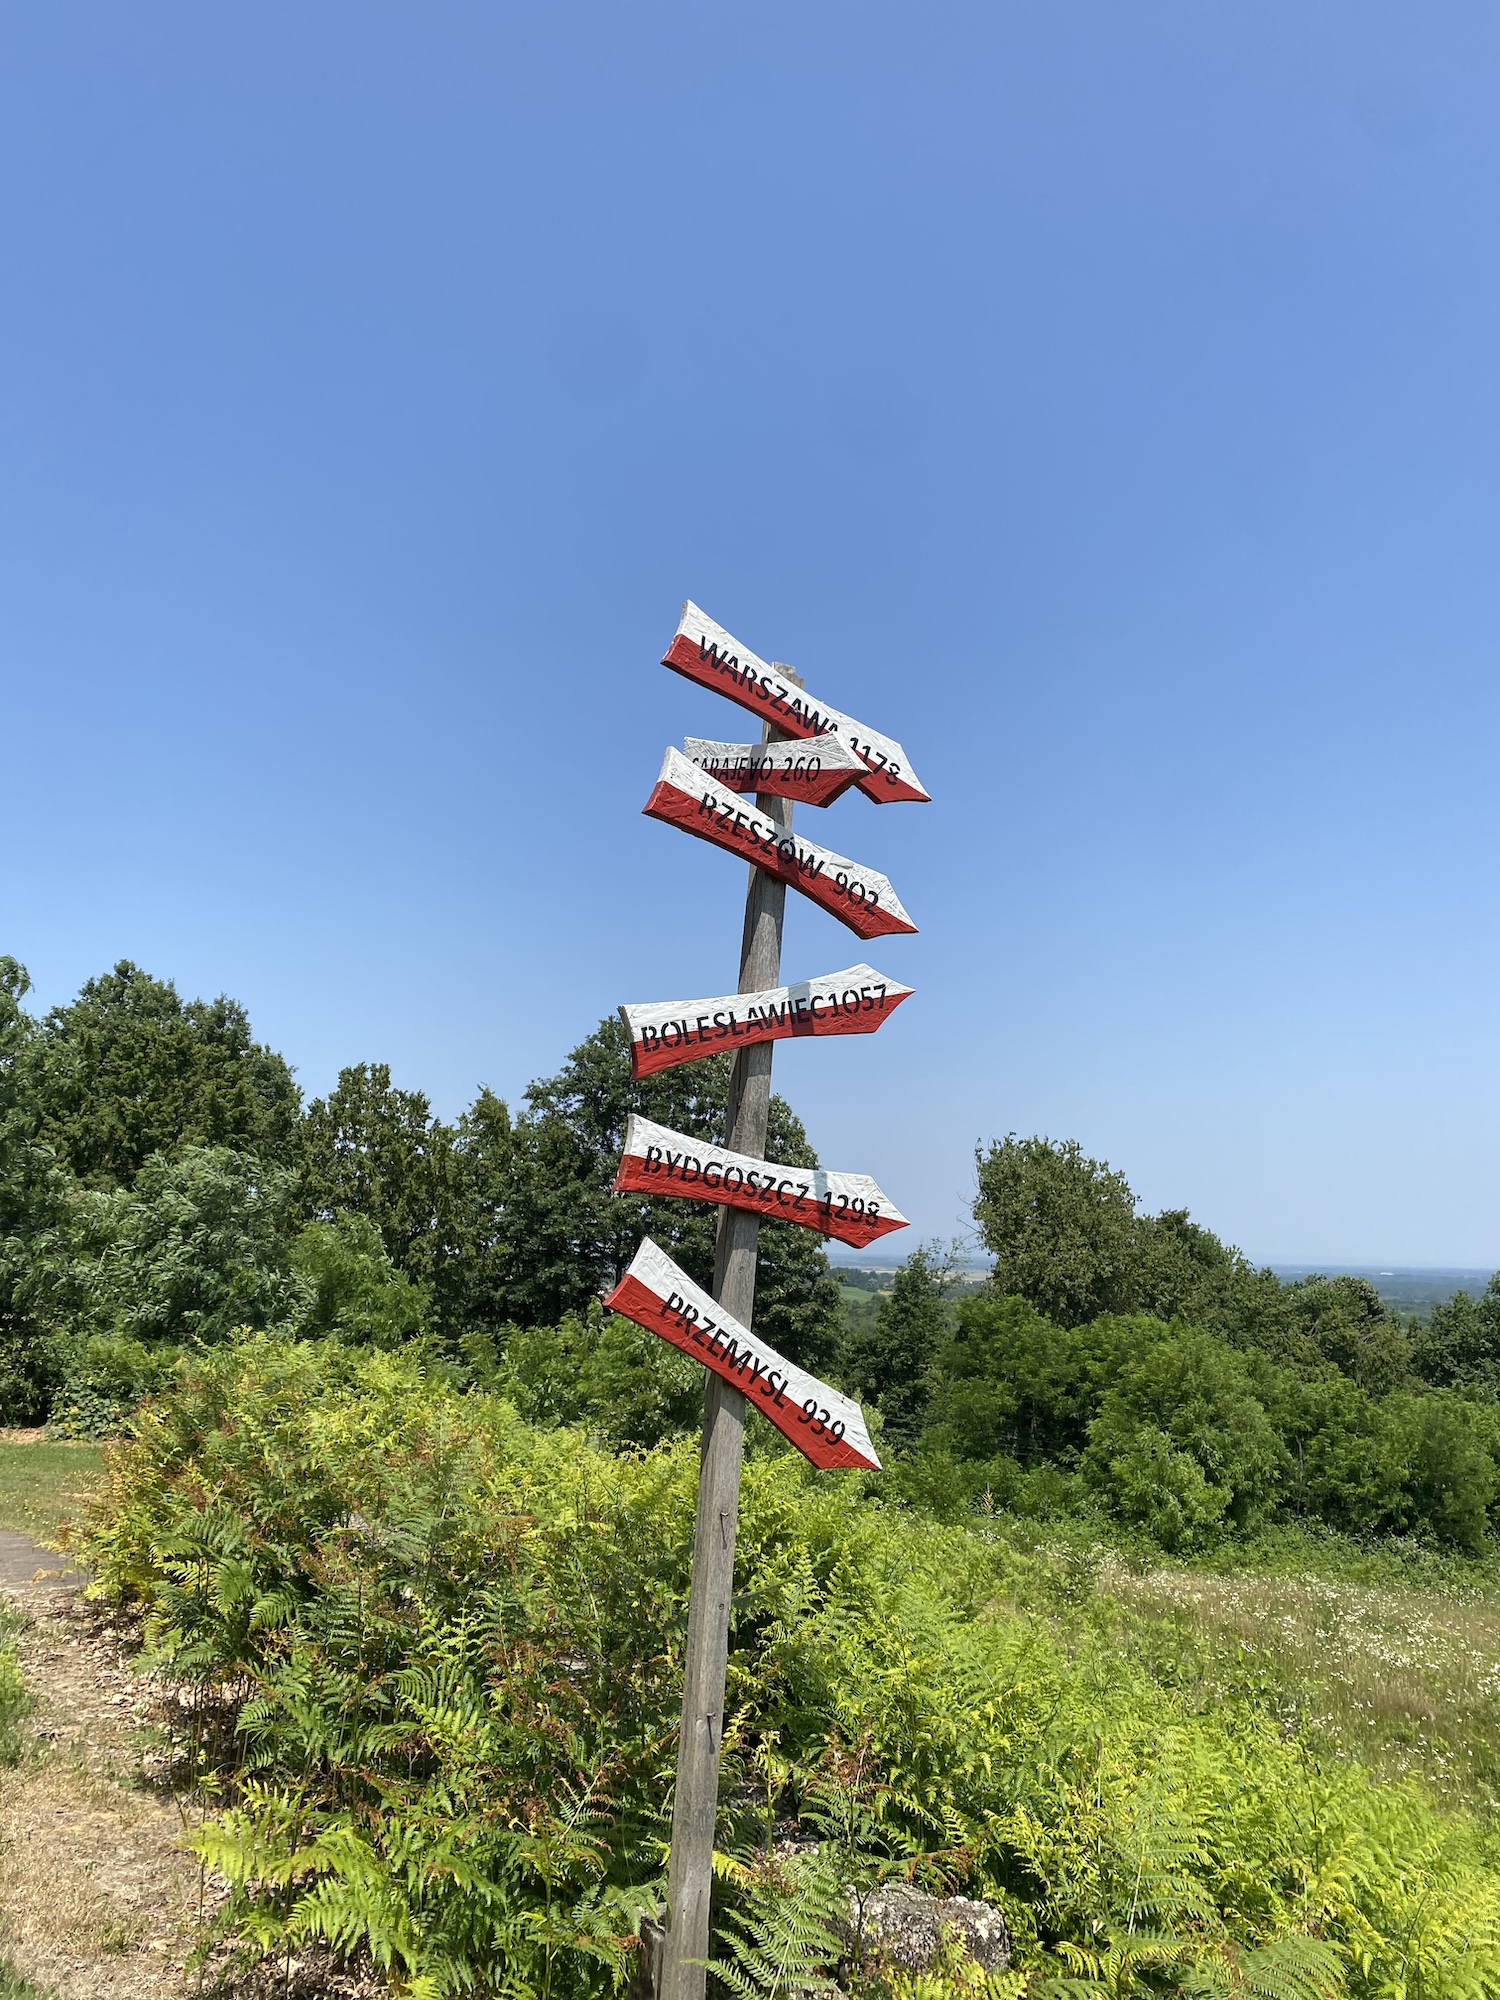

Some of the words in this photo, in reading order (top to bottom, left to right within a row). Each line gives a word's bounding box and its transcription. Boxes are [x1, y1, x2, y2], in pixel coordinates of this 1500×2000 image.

[780, 756, 821, 782] 260
[850, 737, 901, 785] 1178
[697, 793, 825, 879] RZESZÓW
[832, 872, 879, 916] 902
[643, 1146, 810, 1212] BYDGOSZCZ
[821, 1191, 880, 1228] 1298
[660, 1291, 789, 1409] PRZEMYŚL
[797, 1399, 846, 1446] 939
